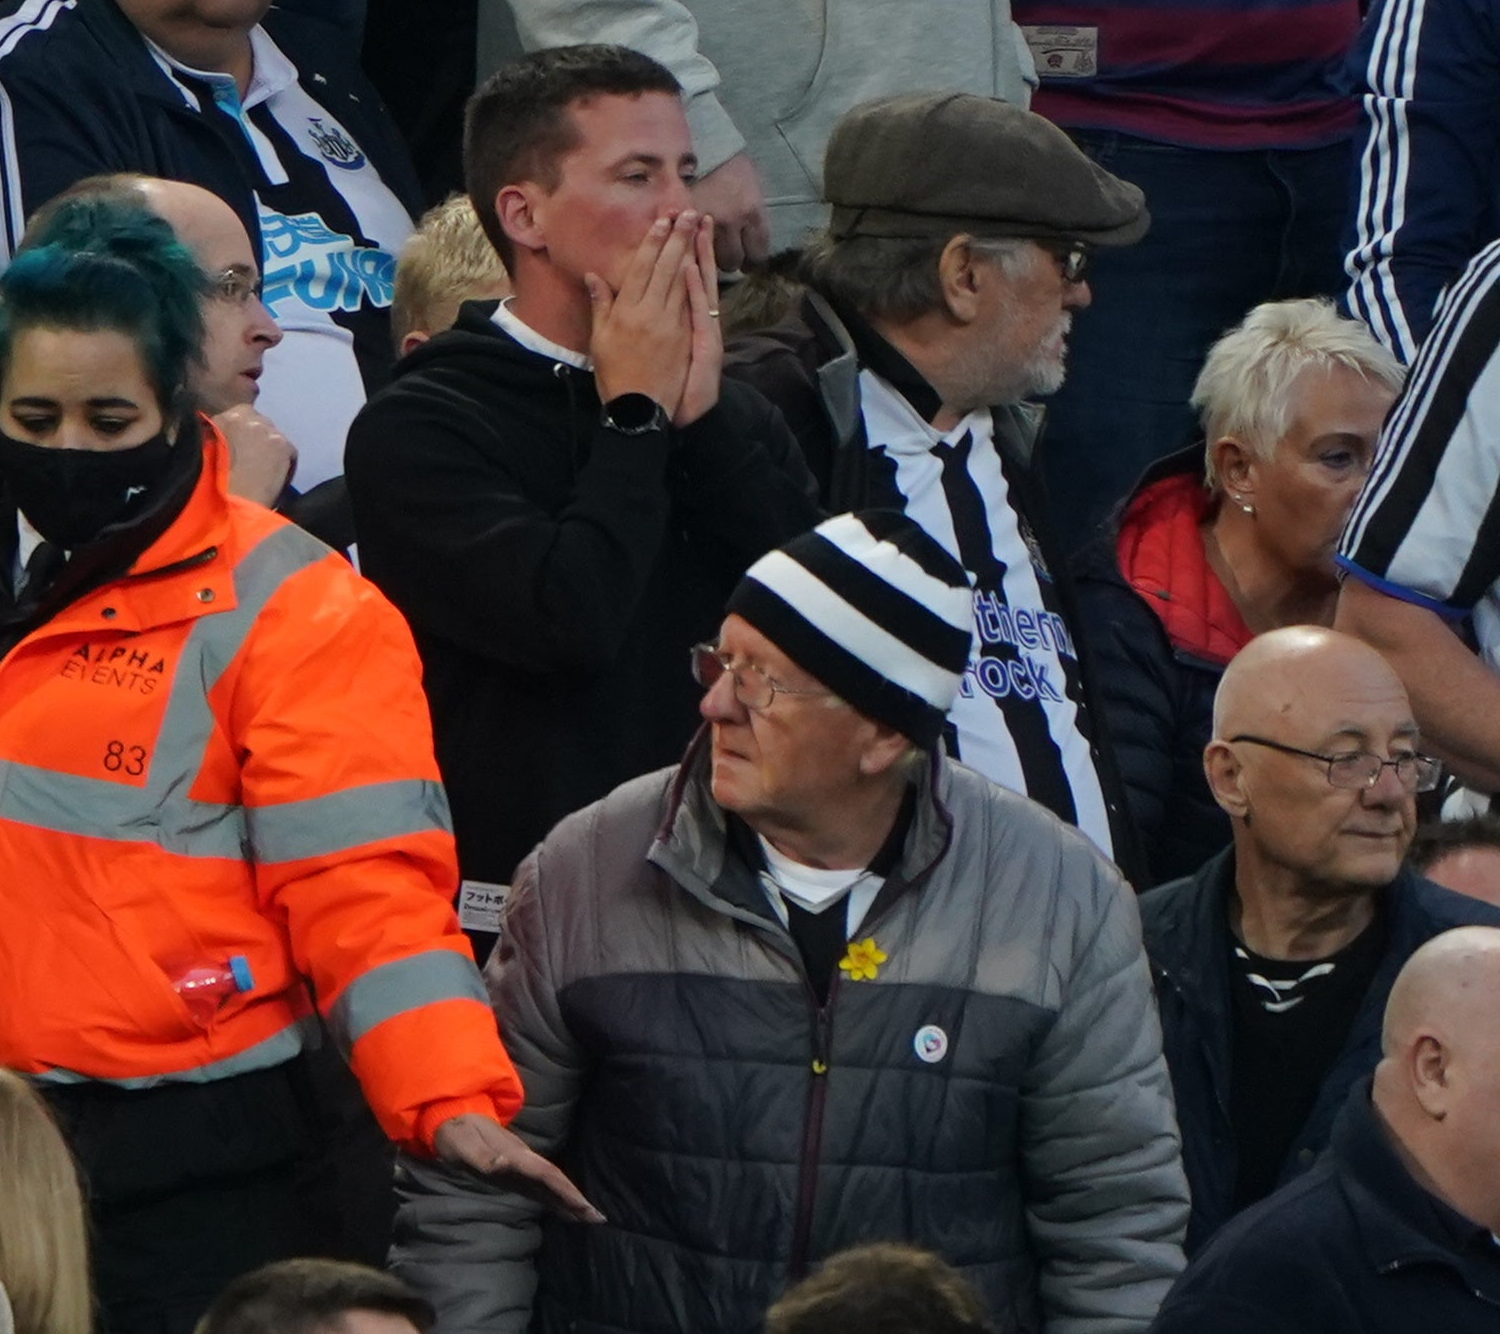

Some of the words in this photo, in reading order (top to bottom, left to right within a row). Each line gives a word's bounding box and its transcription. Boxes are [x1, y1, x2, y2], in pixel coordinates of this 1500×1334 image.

[72, 642, 165, 674] ALPHA
[60, 659, 157, 695] EVENTS
[103, 740, 146, 776] 83
